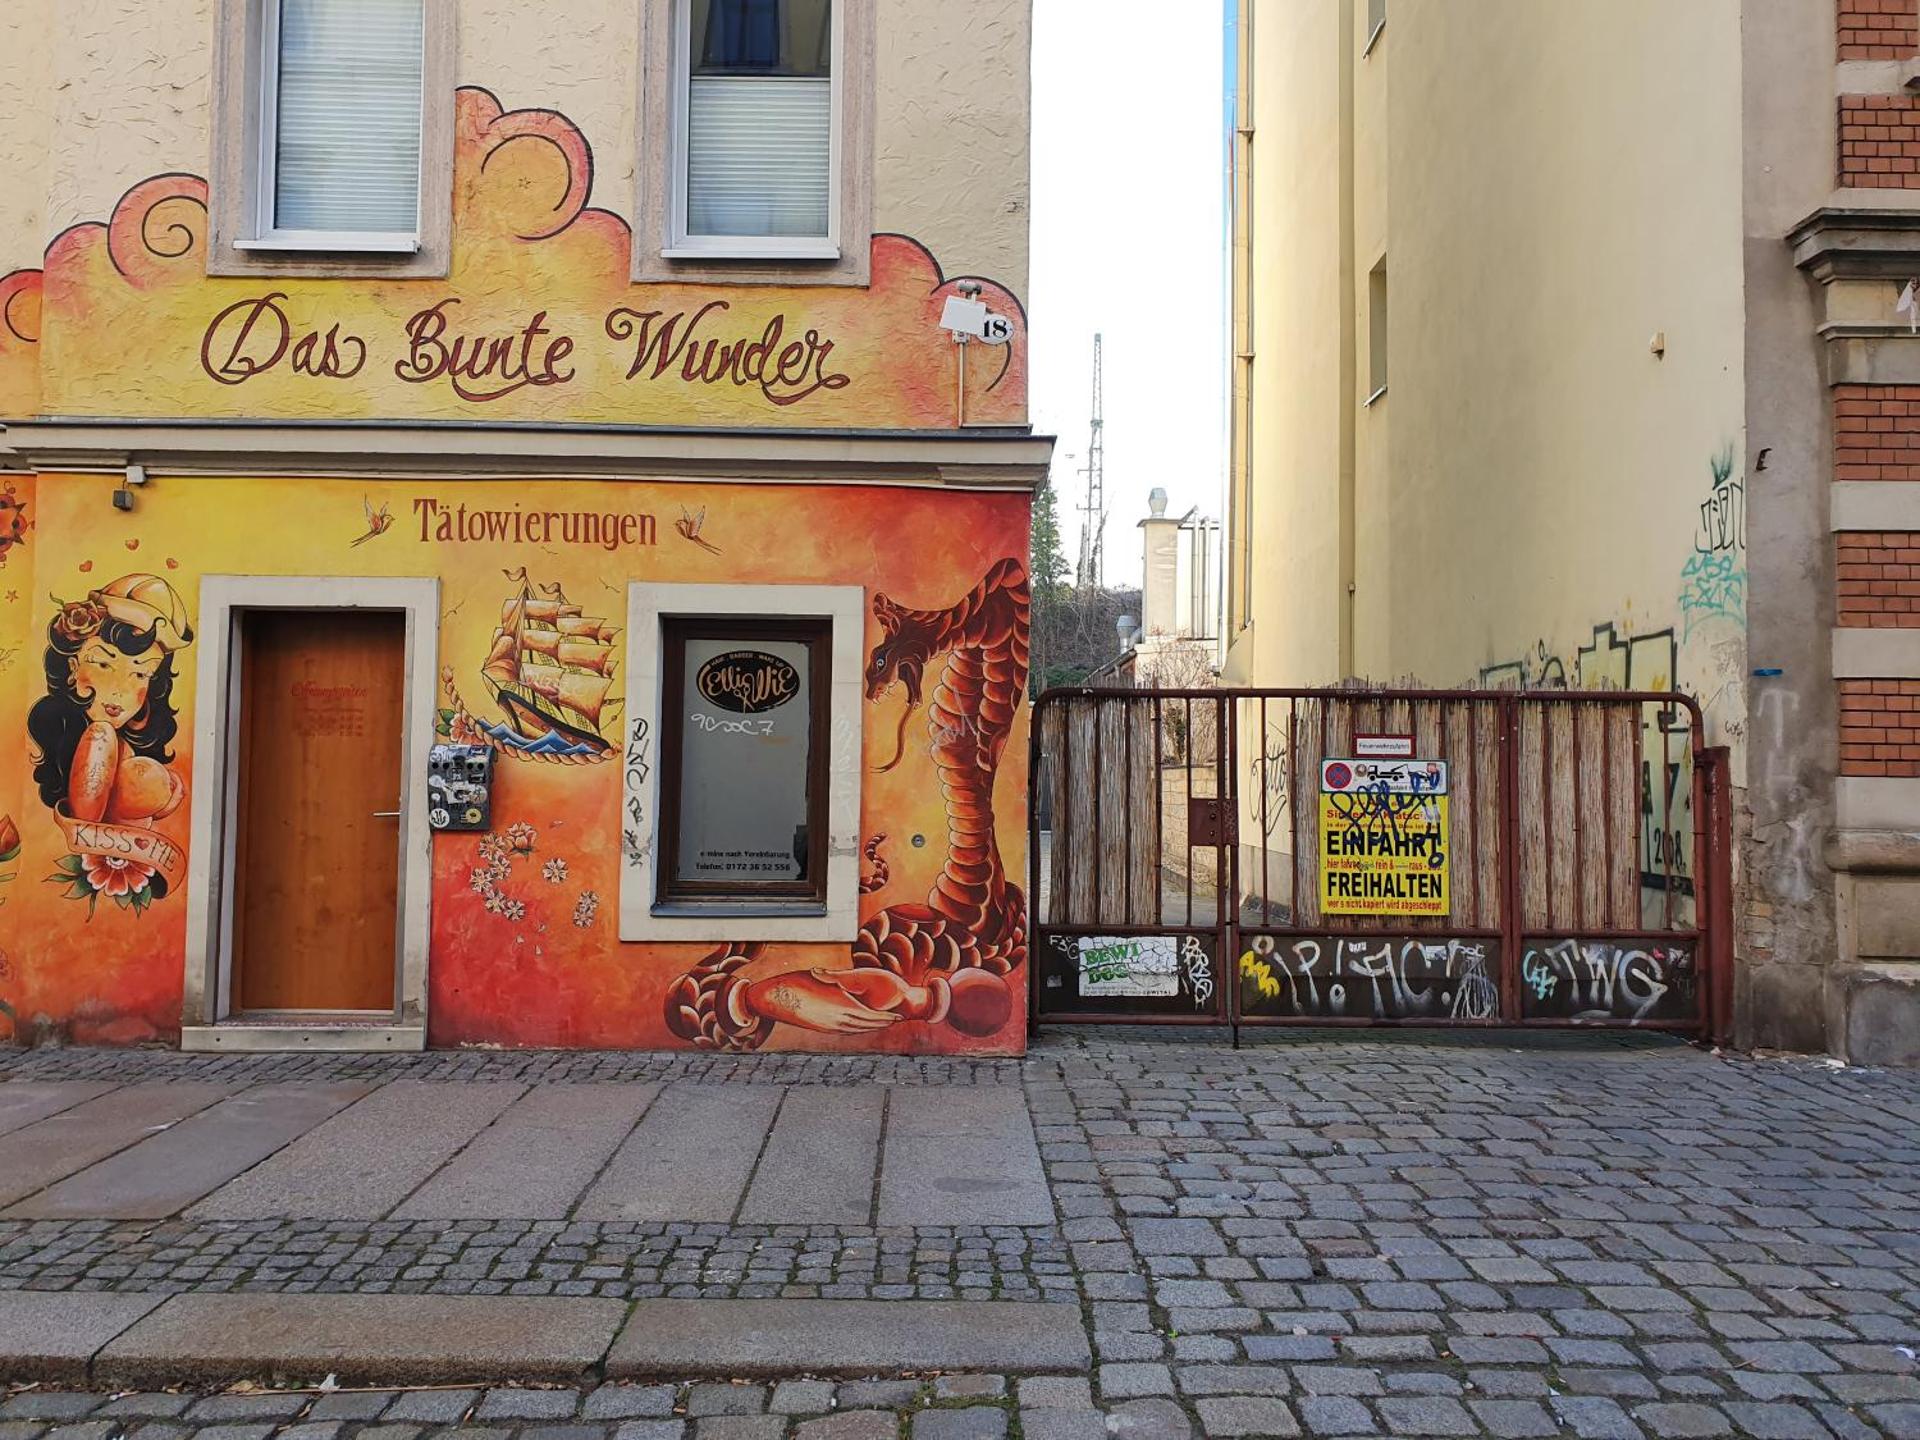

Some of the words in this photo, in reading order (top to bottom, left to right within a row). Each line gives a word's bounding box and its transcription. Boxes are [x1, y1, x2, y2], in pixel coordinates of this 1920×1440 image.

[983, 319, 1008, 338] 18
[201, 293, 366, 384] Das
[395, 298, 575, 401] Bunte
[605, 300, 851, 406] Wunder
[413, 498, 658, 551] Tätowierungen
[74, 823, 133, 853] KISS
[149, 838, 182, 872] ME
[1327, 830, 1438, 857] EINFAHRT
[1327, 871, 1442, 898] FREIHALTEN
